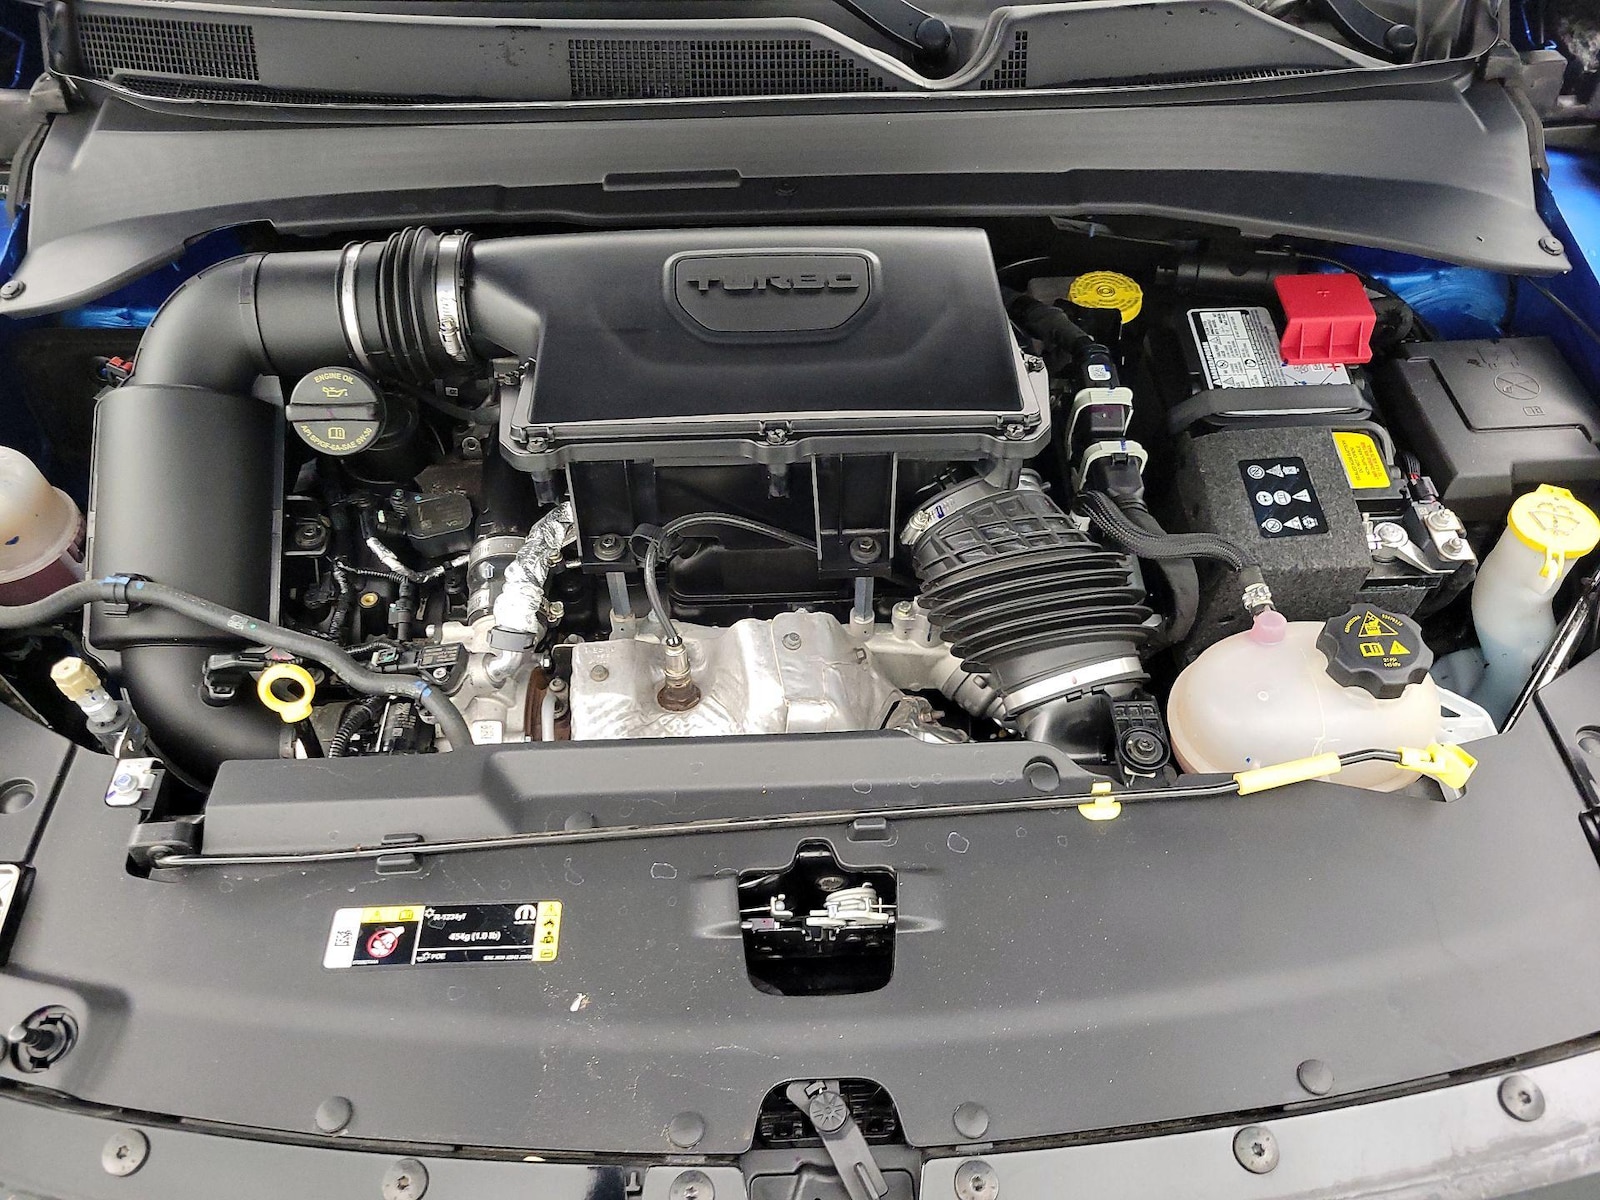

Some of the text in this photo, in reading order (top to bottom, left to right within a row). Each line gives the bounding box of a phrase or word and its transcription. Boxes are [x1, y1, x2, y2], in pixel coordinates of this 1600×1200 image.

[687, 273, 859, 290] TURBO
[314, 373, 354, 385] ENGINE OIL
[301, 425, 312, 437] API
[356, 427, 372, 445] 5W-30
[448, 932, 470, 942] 454g
[430, 952, 447, 960] POE
